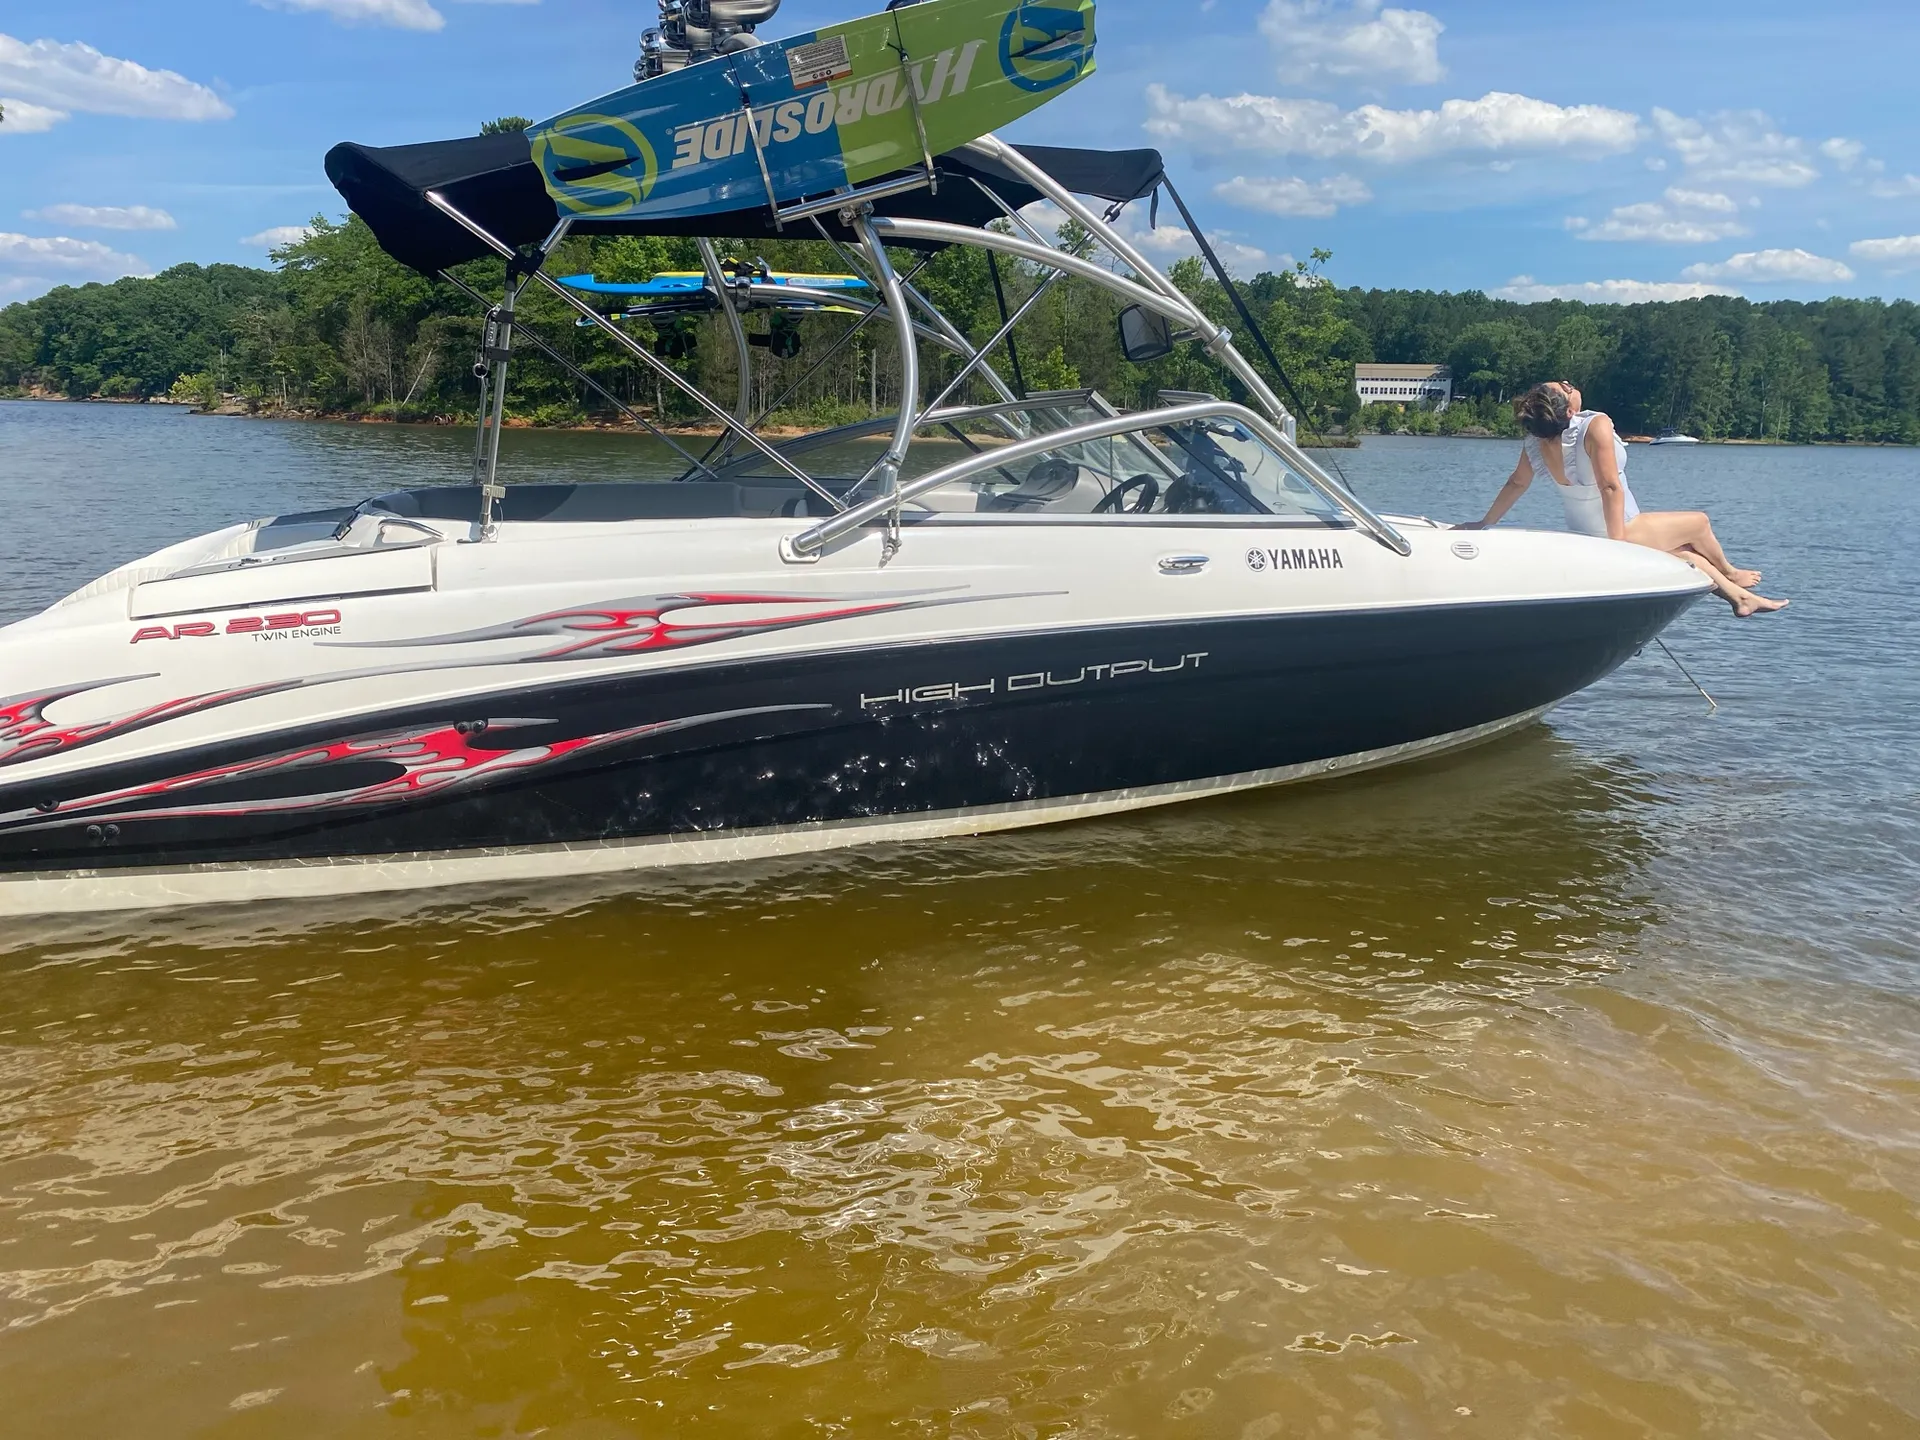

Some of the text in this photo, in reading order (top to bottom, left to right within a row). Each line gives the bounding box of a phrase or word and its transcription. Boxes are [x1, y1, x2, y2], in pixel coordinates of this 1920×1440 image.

[672, 38, 987, 169] HYDROSLIDE
[1268, 548, 1344, 570] YAMAHA
[130, 609, 342, 644] AR 230
[252, 626, 342, 643] TWIN ENGINE
[860, 652, 1209, 709] HIGH OUTPUT
